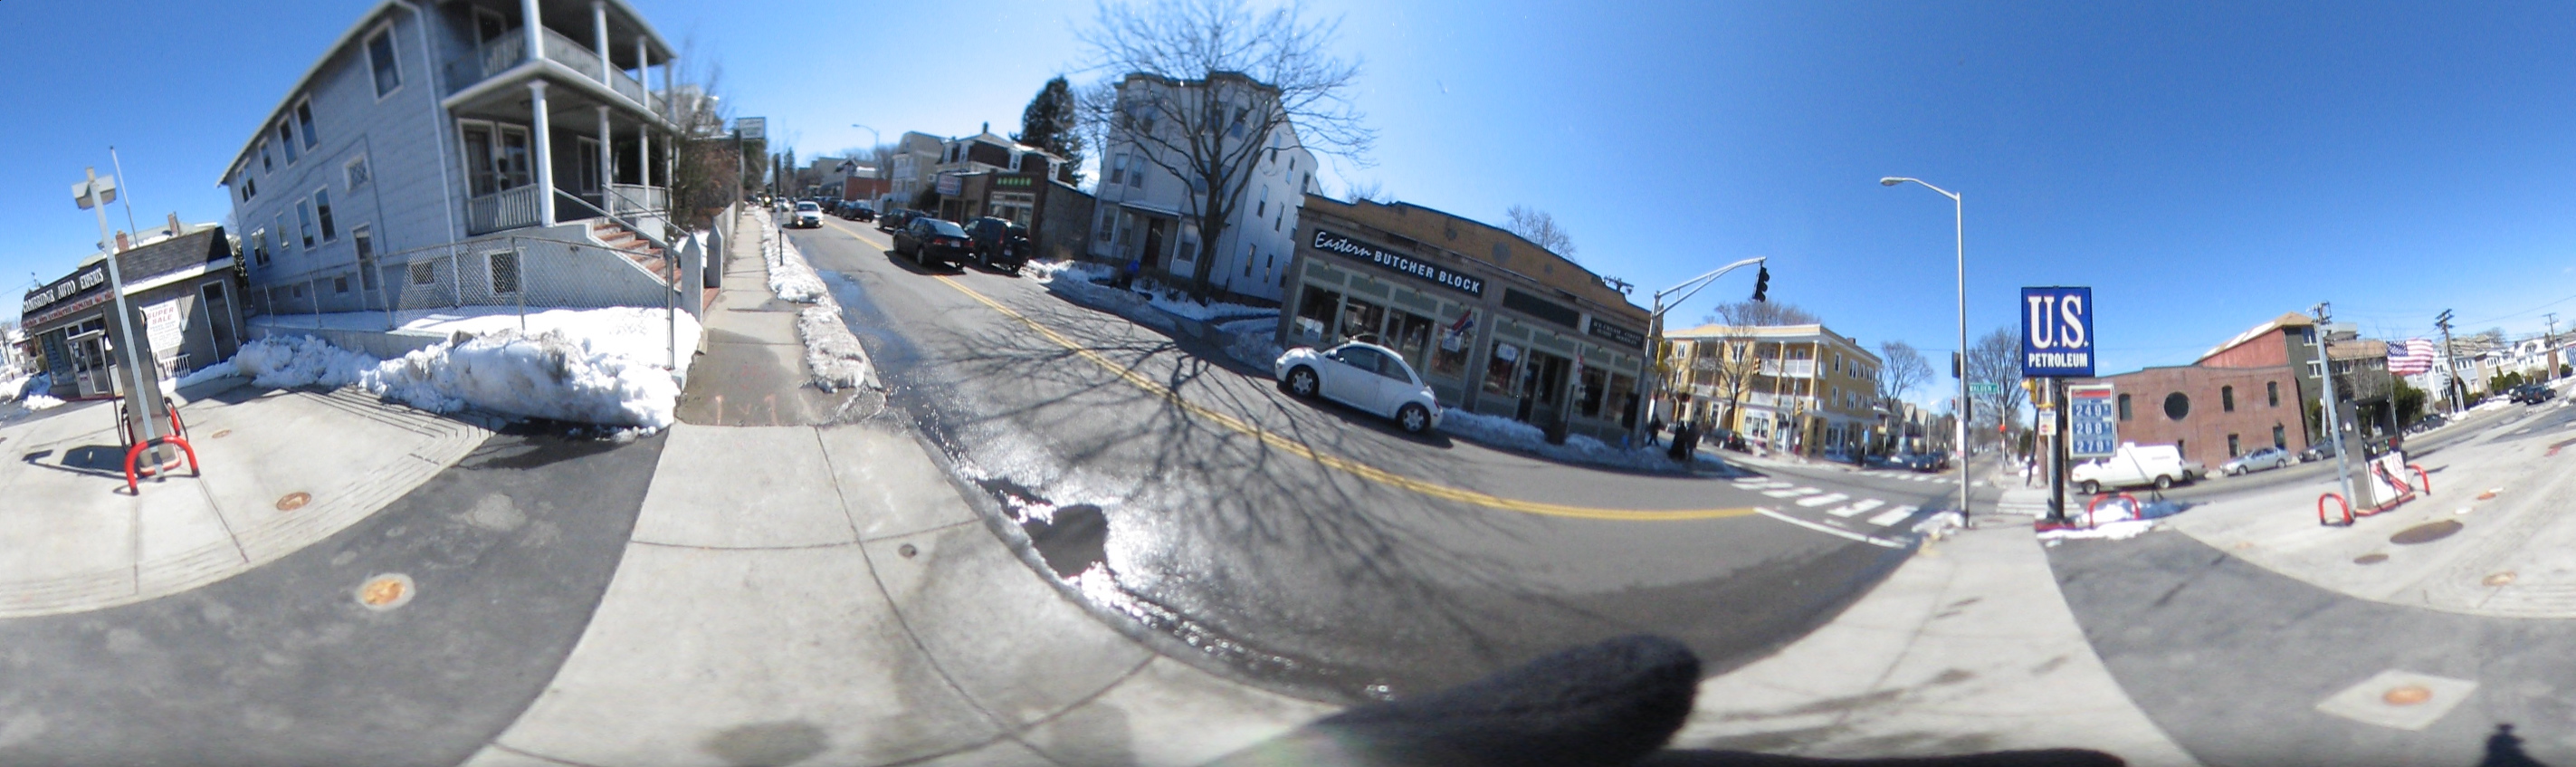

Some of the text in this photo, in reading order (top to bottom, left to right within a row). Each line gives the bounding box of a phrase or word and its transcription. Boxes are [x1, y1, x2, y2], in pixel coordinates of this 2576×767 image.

[1314, 232, 1481, 293] Eastern BUTCHER BLOCK
[57, 279, 76, 300] AUTO
[79, 266, 104, 290] EXPERTS
[147, 306, 175, 320] SUPER
[152, 314, 173, 324] SALE
[2027, 294, 2090, 350] U.S.
[2028, 352, 2088, 368] PETROLEUM
